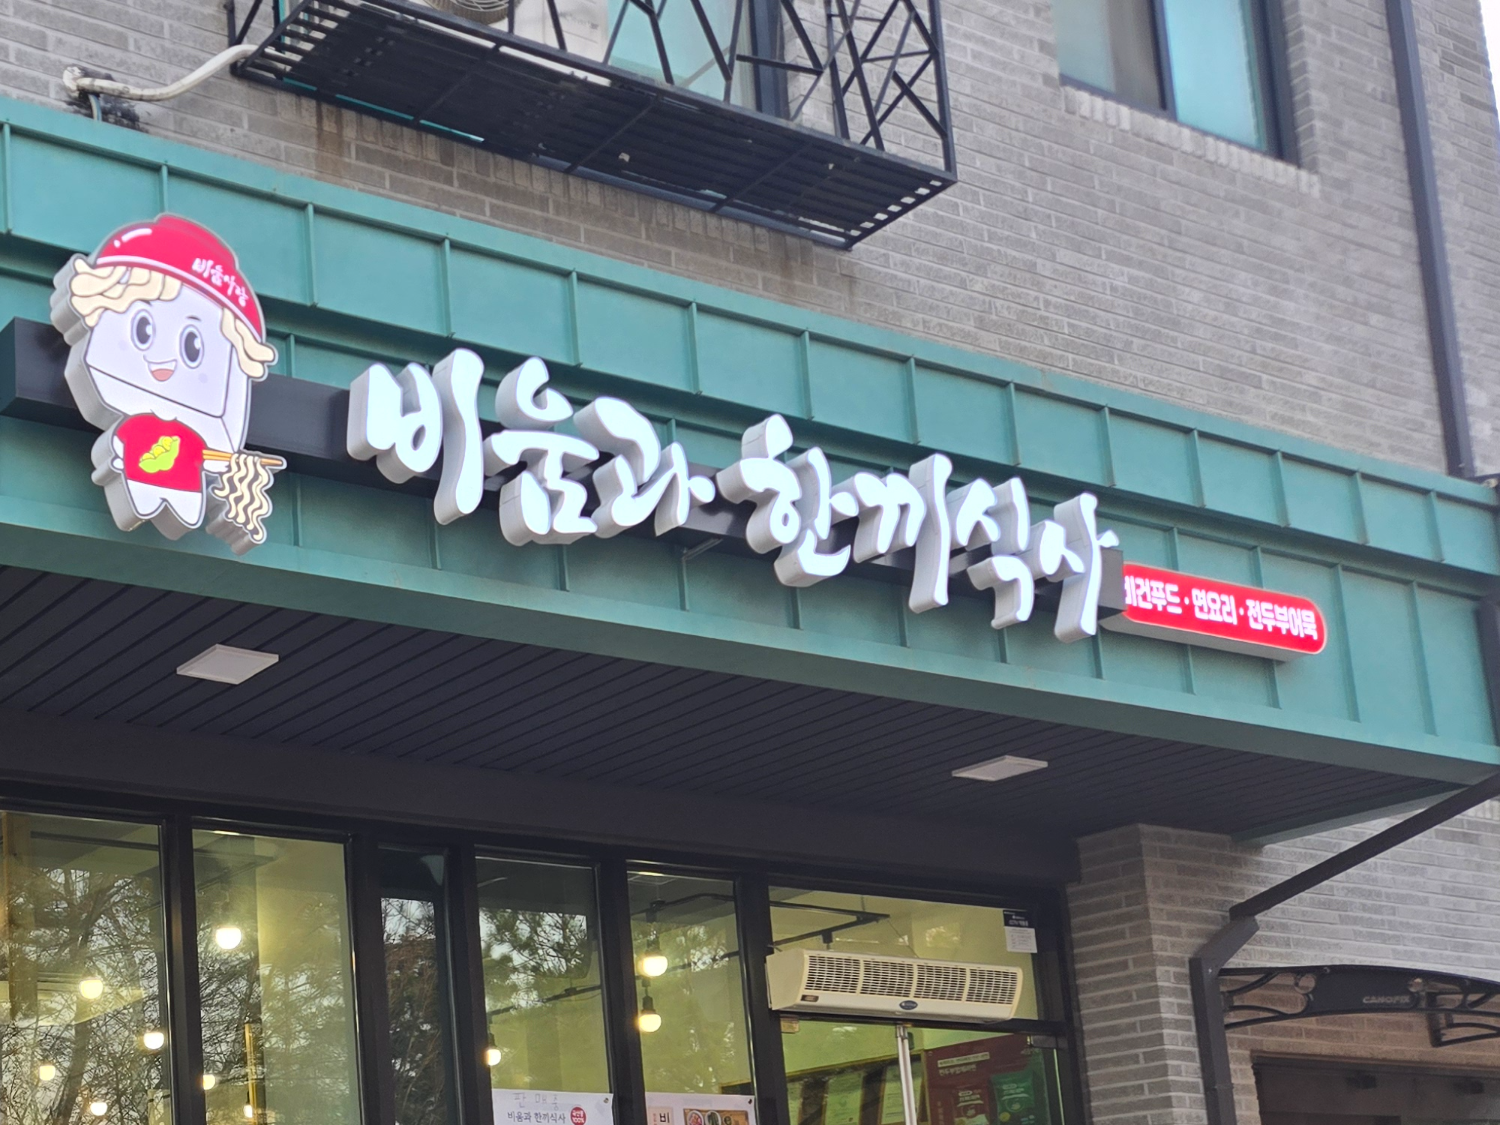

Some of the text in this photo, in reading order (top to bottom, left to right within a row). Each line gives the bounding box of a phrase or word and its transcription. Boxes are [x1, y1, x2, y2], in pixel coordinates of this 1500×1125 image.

[348, 348, 1120, 642] 비움과 한끼식사
[1192, 588, 1237, 625] 면요리
[1246, 599, 1318, 640] 전두부어묵
[507, 1111, 566, 1123] 비움과 한끼식사
